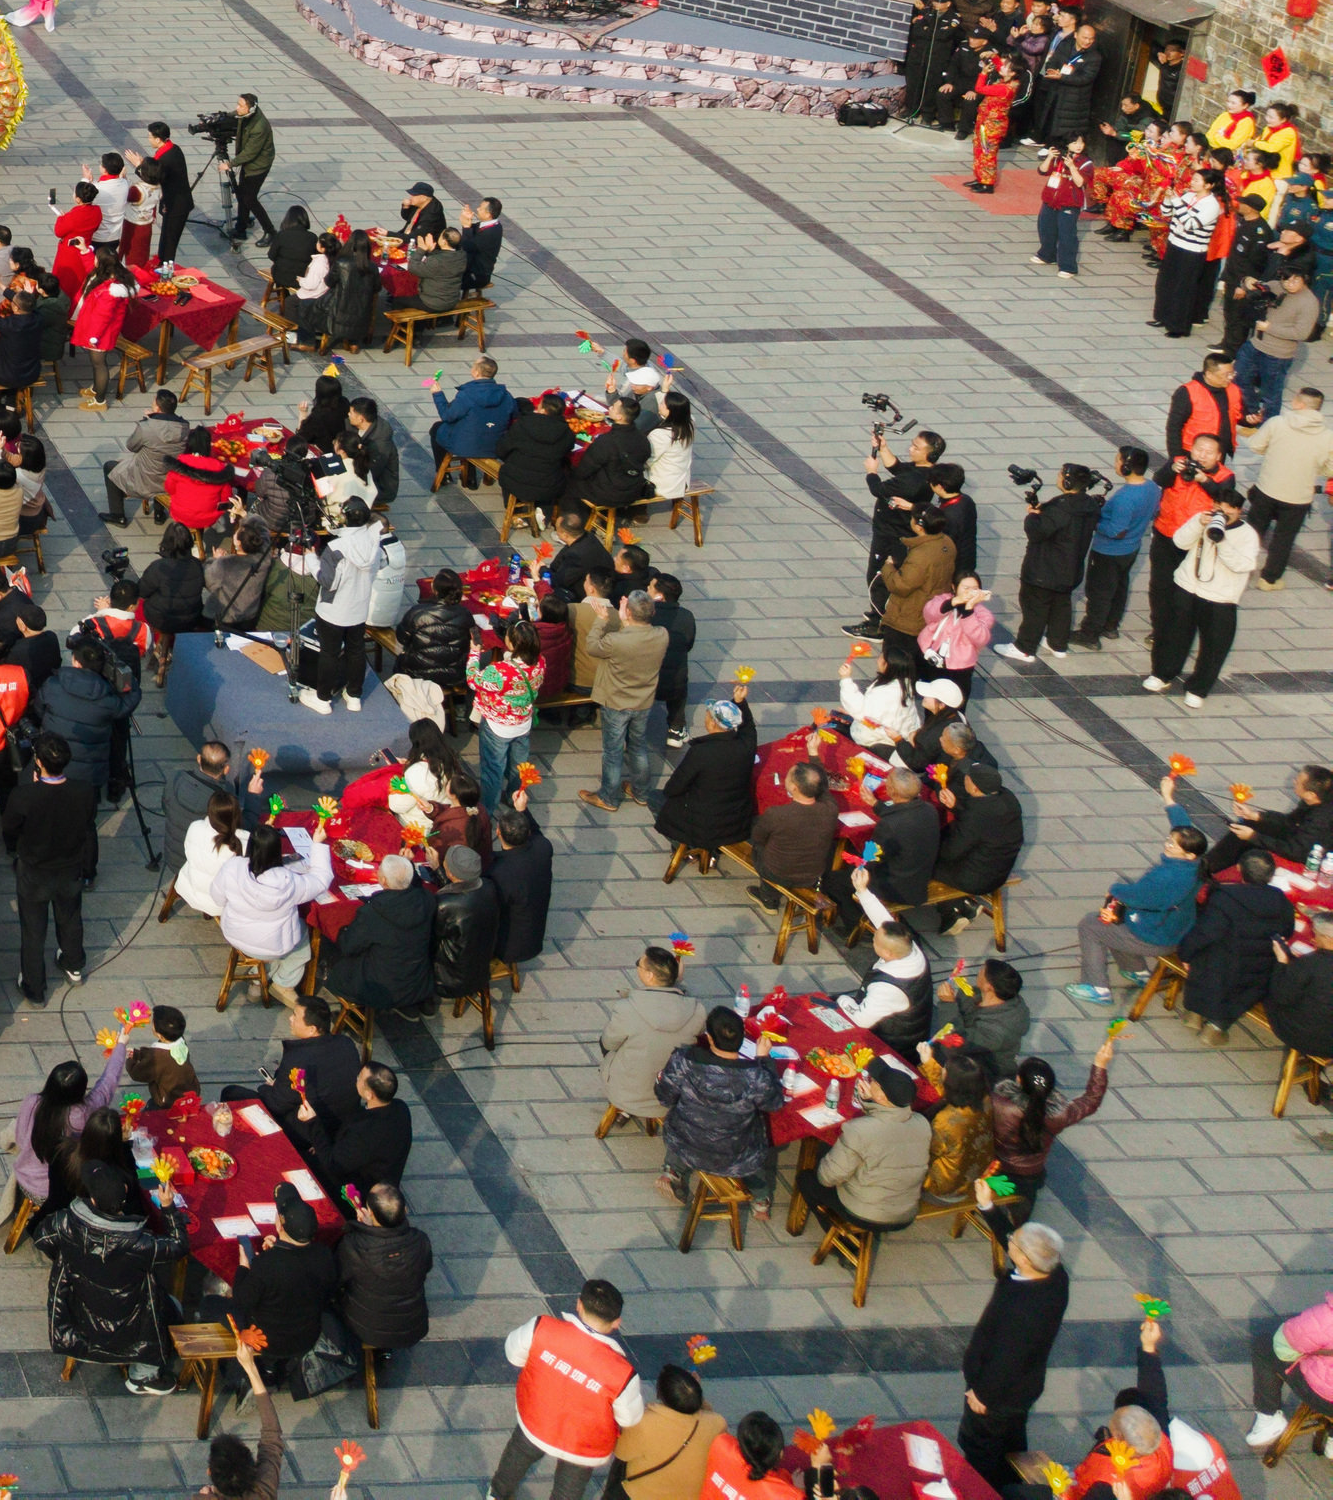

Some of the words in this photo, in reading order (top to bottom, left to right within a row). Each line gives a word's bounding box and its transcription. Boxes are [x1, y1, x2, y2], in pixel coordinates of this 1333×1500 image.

[228, 418, 236, 426] 13
[540, 1350, 602, 1393] 新闻媒体
